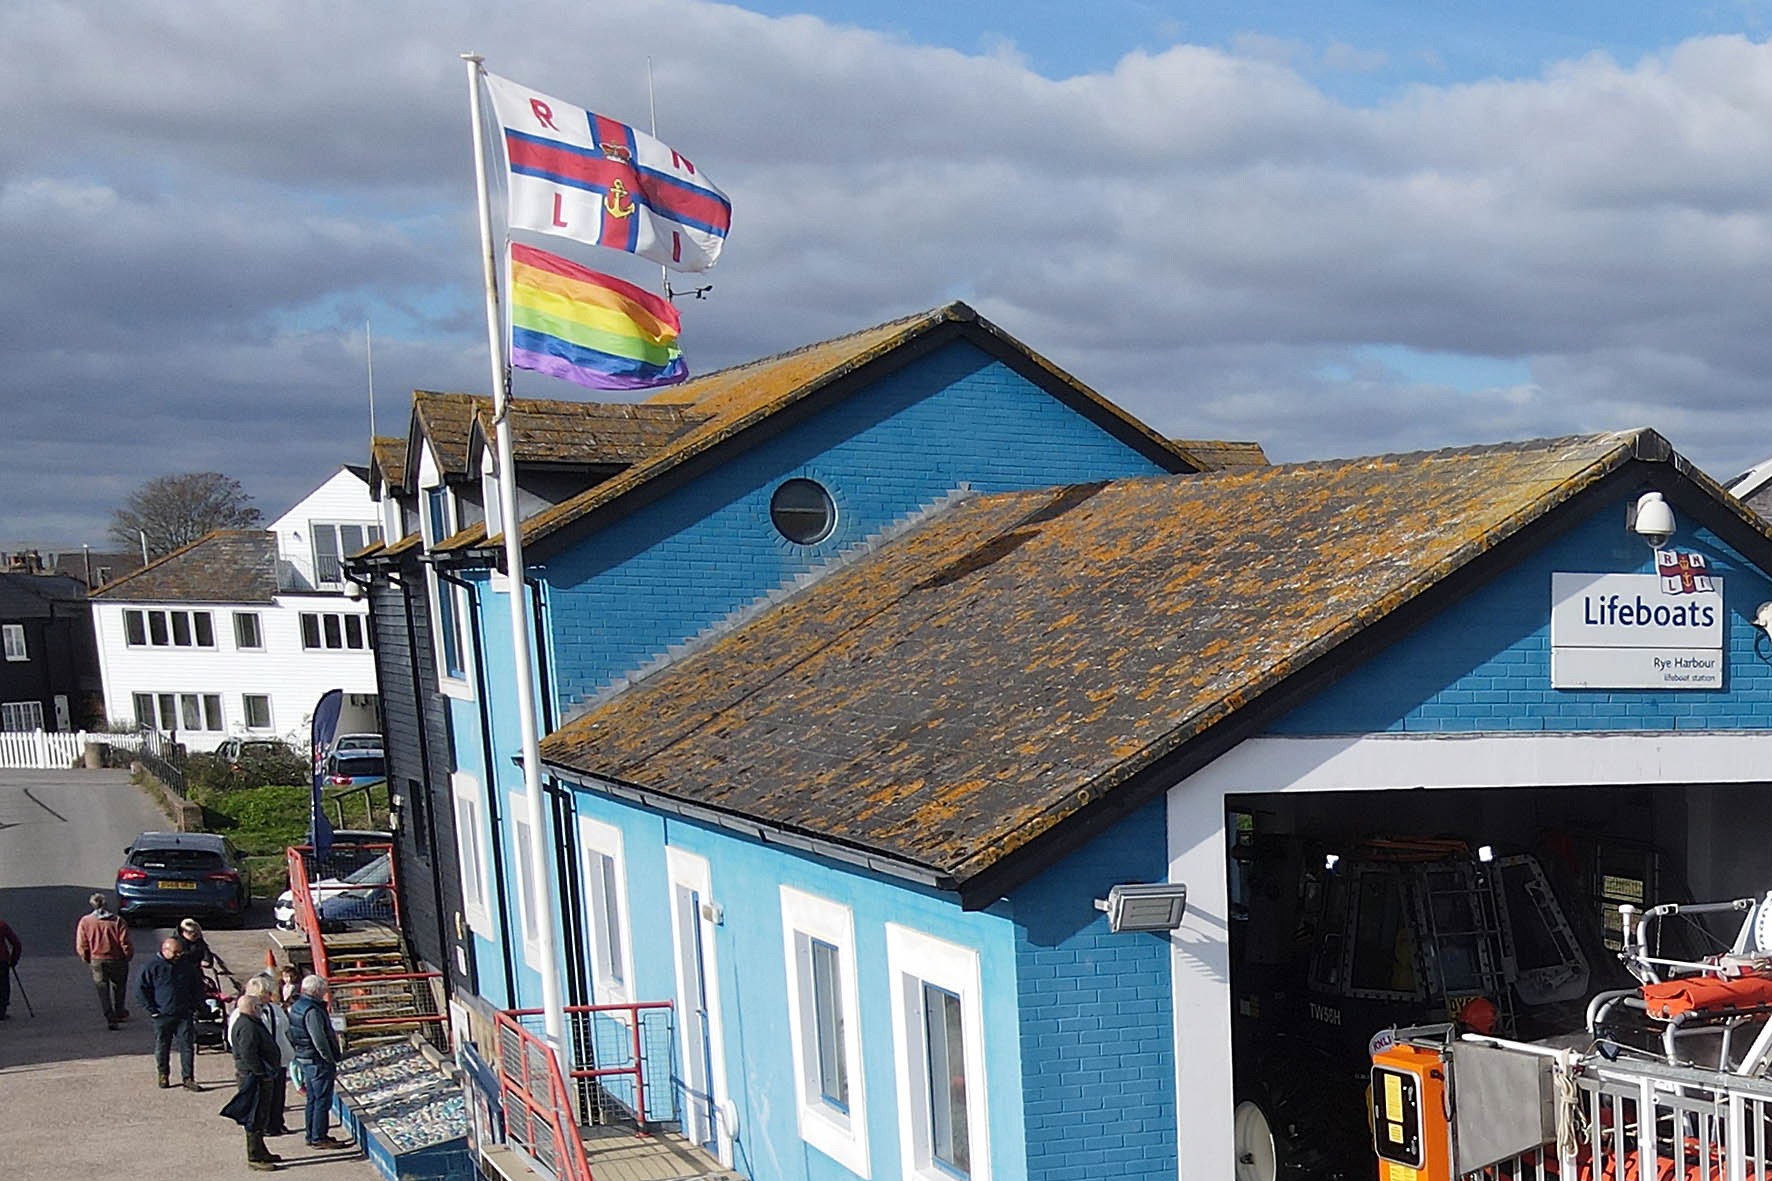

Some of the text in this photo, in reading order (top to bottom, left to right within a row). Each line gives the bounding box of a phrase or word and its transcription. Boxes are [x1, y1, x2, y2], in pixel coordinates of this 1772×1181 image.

[1584, 595, 1714, 627] Lifeboats
[1654, 657, 1715, 671] Rye Harbour
